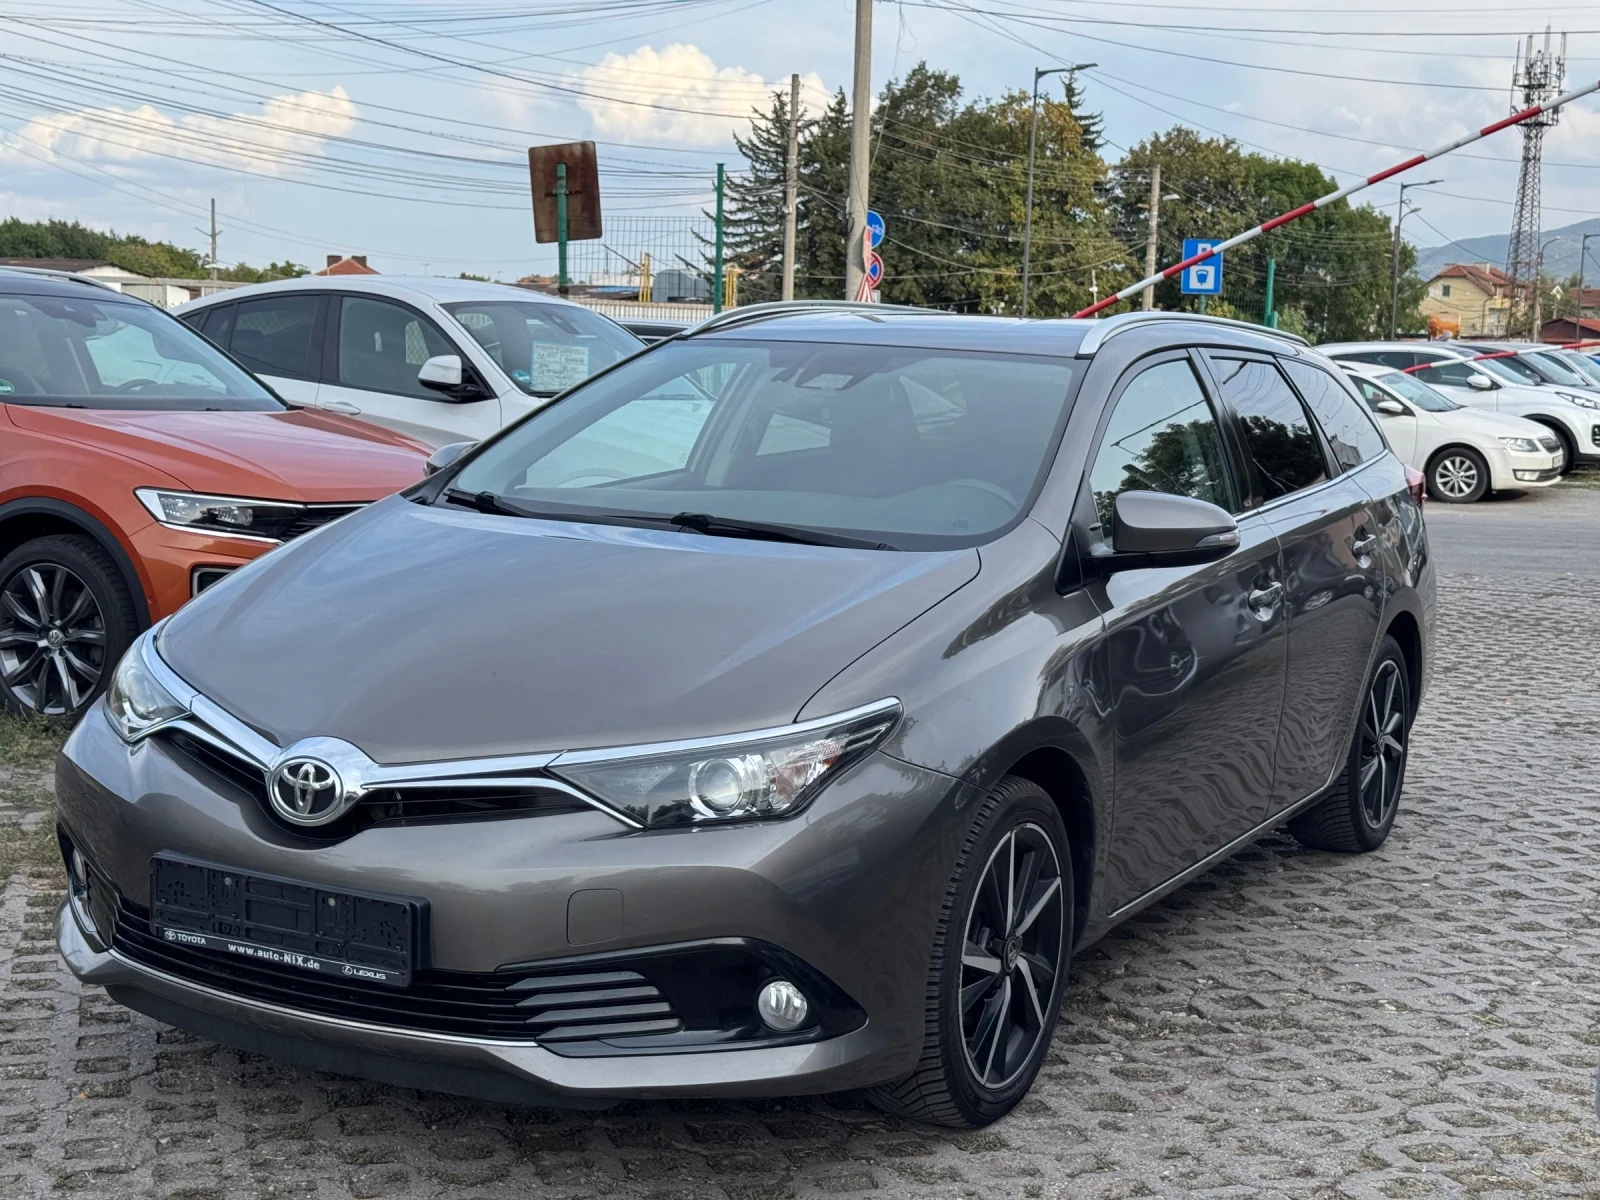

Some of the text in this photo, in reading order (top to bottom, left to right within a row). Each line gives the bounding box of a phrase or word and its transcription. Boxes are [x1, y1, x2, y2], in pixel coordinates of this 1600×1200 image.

[177, 933, 207, 945] TOYOTA
[227, 943, 320, 970] www.auto-NIX.de
[353, 968, 386, 980] LEXUS
